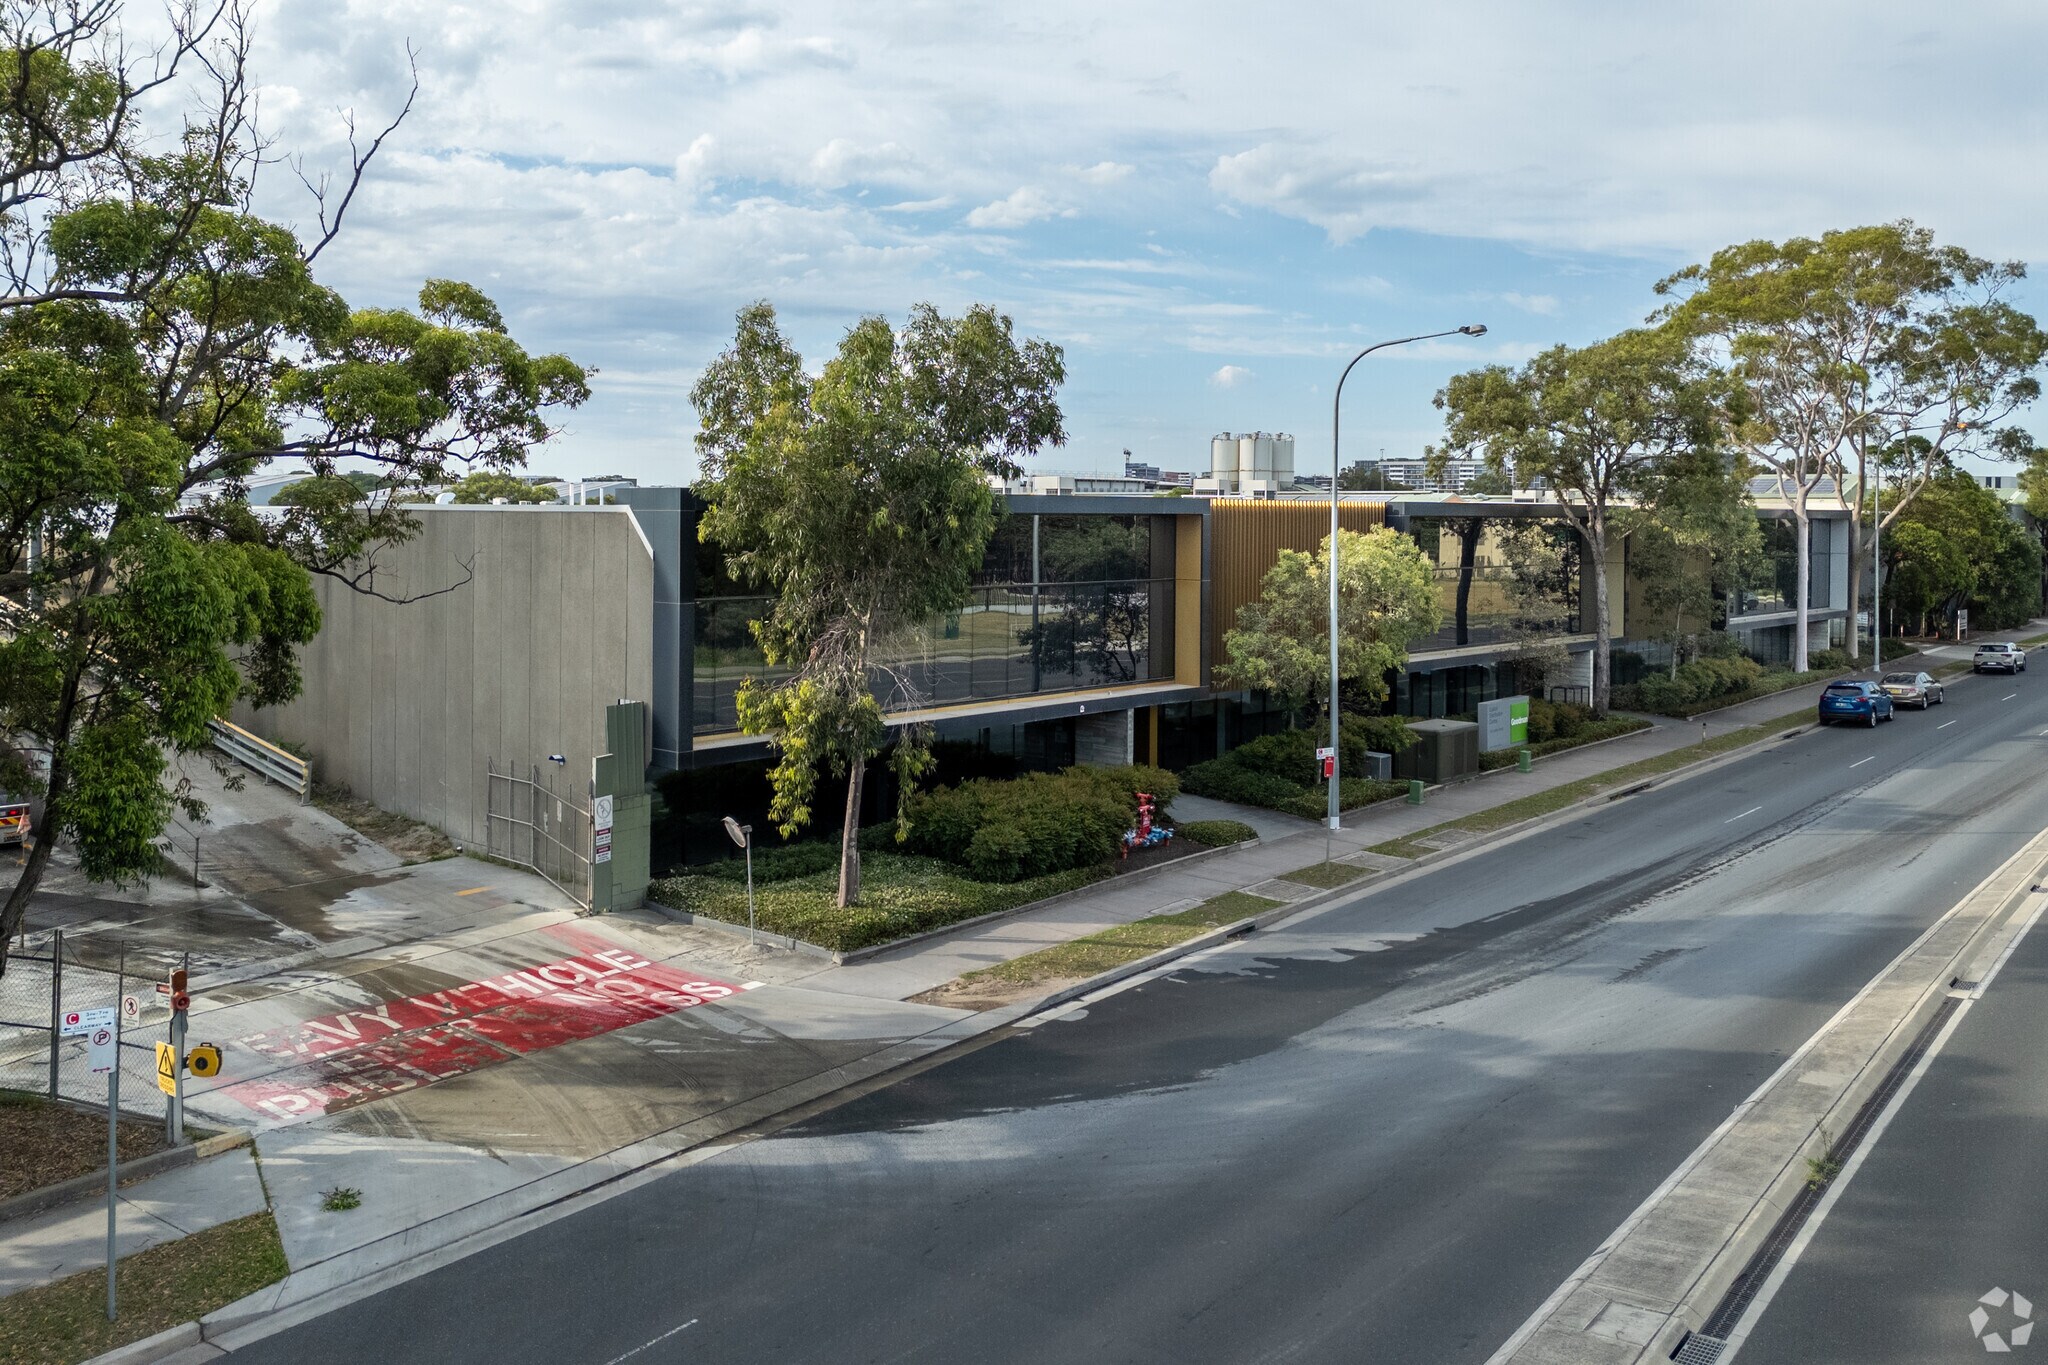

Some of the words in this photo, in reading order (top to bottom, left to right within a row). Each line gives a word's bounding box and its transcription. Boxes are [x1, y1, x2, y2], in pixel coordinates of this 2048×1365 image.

[230, 1004, 403, 1058] EAVY
[408, 949, 651, 1014] VEHICLE
[256, 1060, 463, 1120] PUBL
